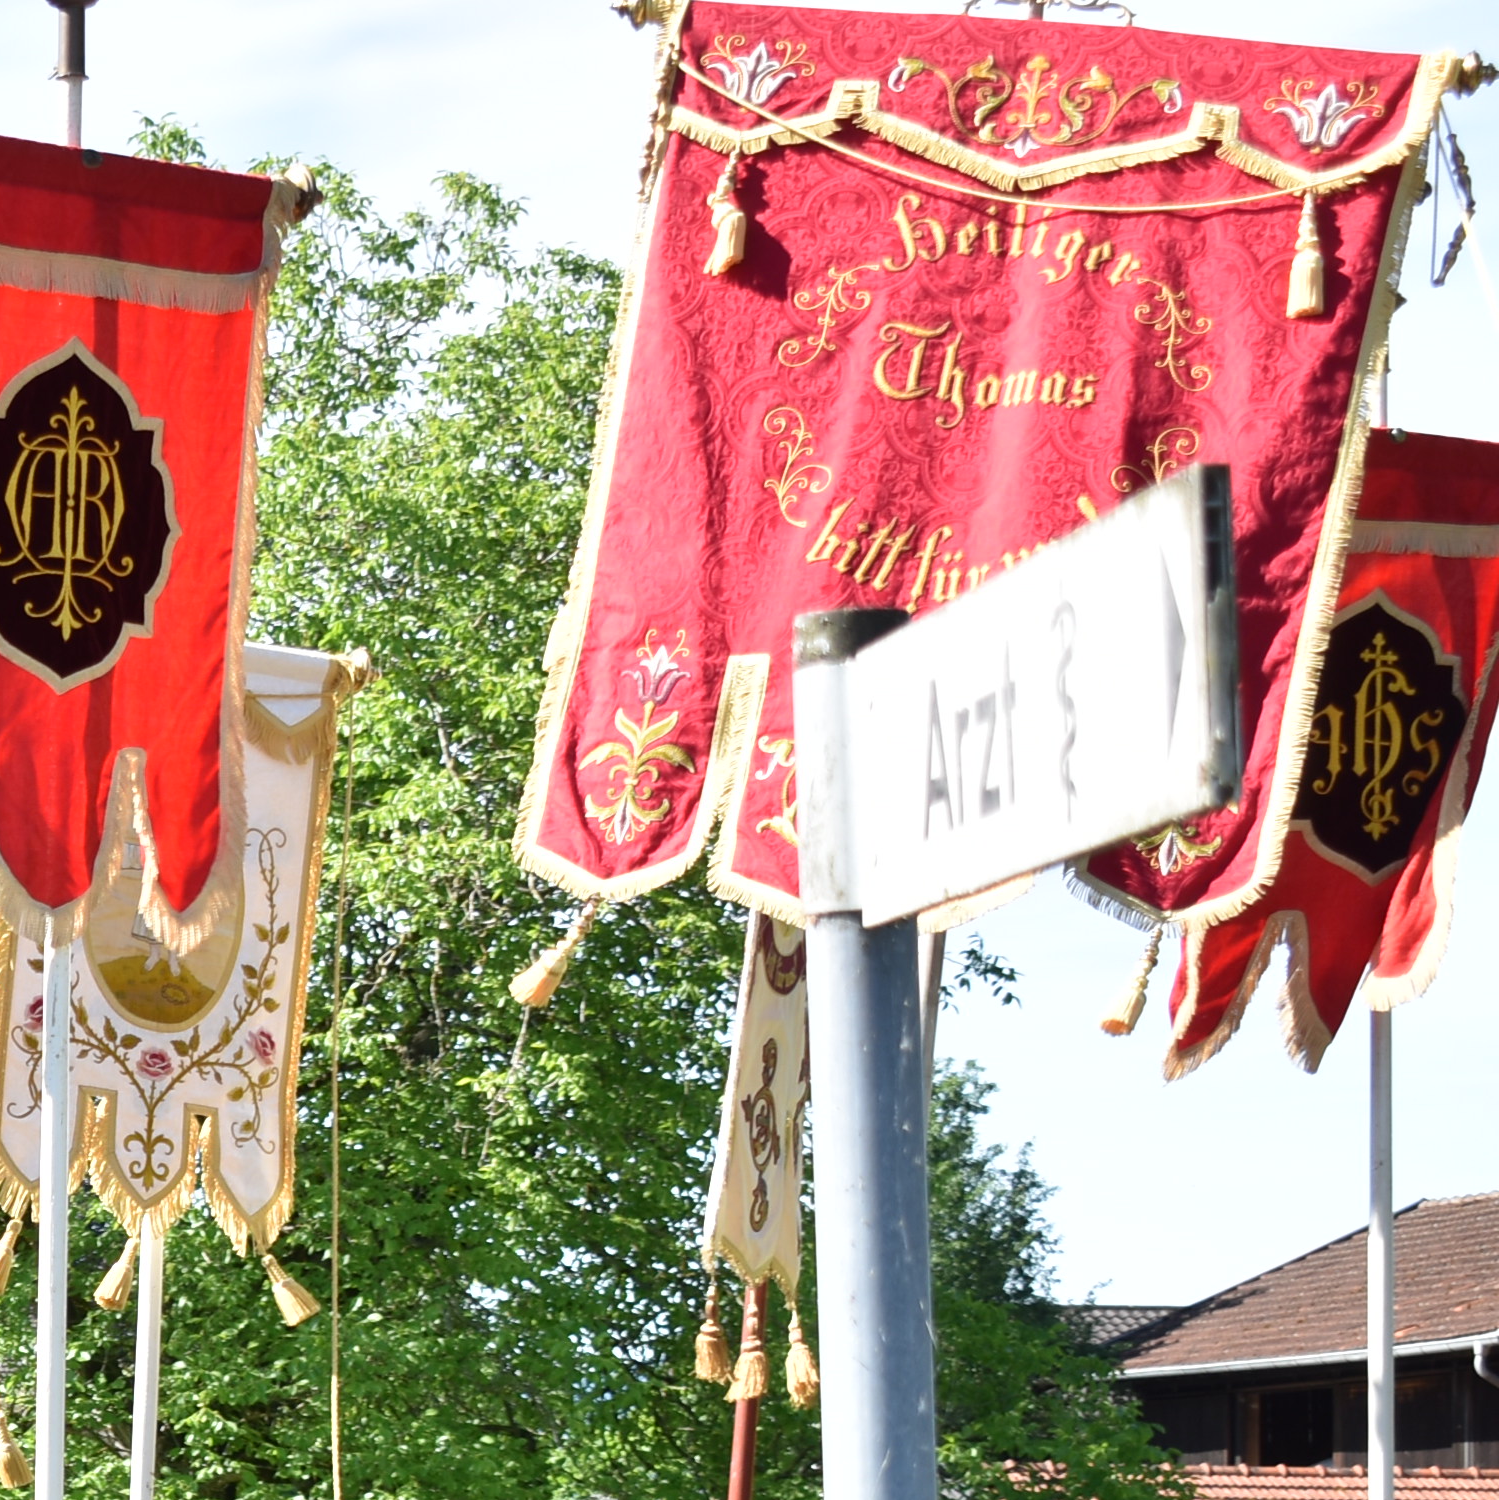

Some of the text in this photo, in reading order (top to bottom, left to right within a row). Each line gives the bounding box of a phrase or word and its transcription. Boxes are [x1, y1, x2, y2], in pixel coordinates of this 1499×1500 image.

[883, 195, 1141, 286] Heiliger
[874, 320, 1100, 428] Thomas
[806, 497, 916, 590] bitt
[923, 639, 1016, 841] Arzt
